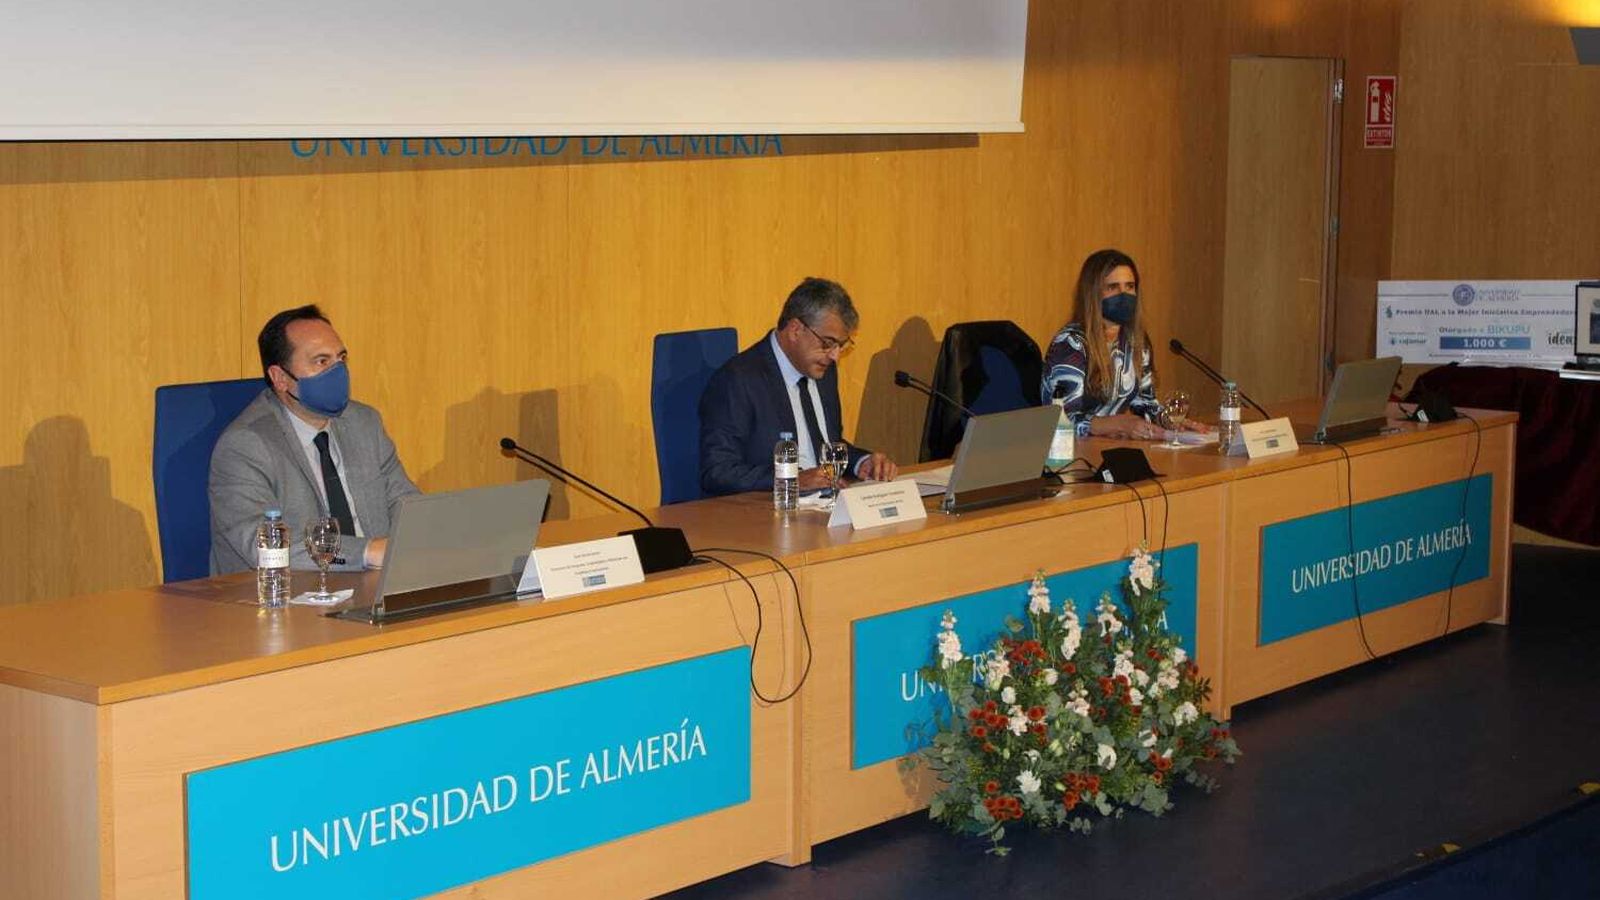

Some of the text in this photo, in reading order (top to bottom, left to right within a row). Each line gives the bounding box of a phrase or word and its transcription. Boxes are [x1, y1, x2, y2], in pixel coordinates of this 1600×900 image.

[1521, 309, 1575, 317] Emprendedor
[1464, 338, 1495, 348] 1.000
[1292, 518, 1472, 593] UNIVERSIDAD DE ALMERÍA
[270, 718, 707, 873] UNIVERSIDAD DE ALMERÍA
